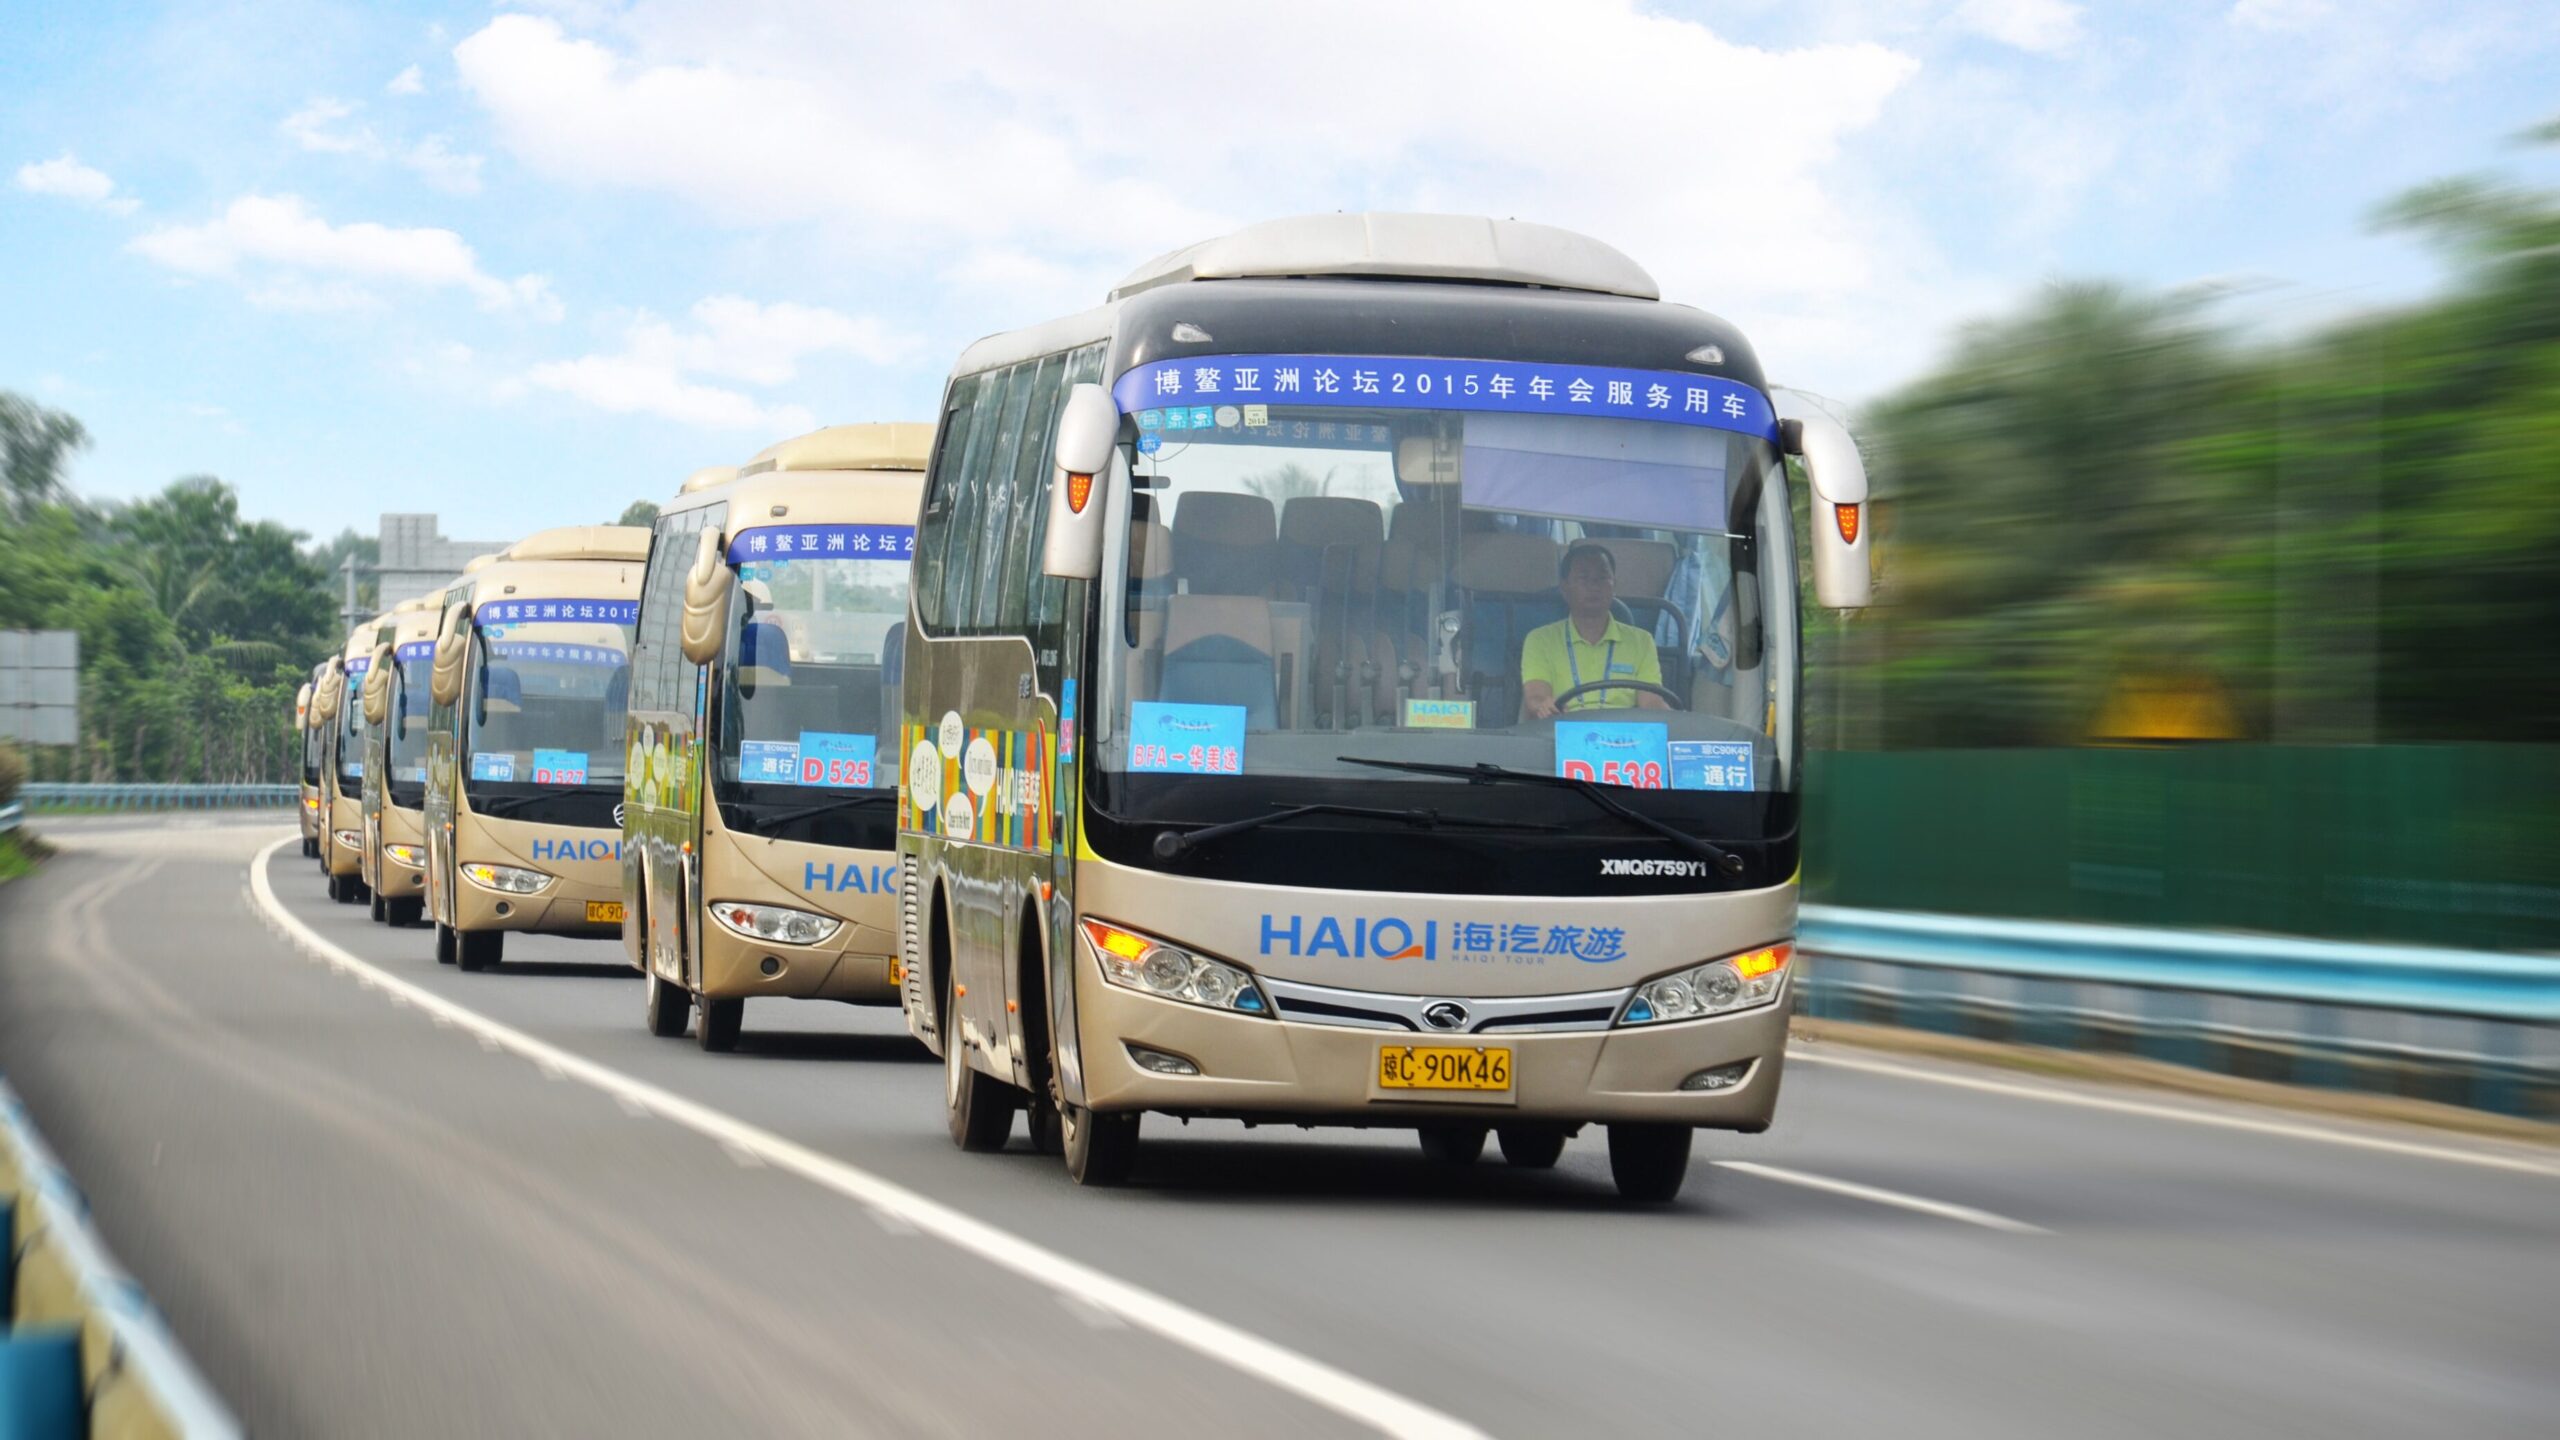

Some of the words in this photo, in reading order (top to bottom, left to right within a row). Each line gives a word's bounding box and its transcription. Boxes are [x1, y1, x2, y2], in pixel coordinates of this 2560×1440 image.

[1154, 367, 1746, 419] 博鳌亚洲论坛2015年年会服务用车
[763, 757, 794, 774] 通行
[803, 758, 824, 783] D
[829, 759, 870, 785] 525
[1603, 761, 1663, 789] 538
[1703, 764, 1747, 787] 通行
[533, 839, 622, 861] HAIQI
[1600, 859, 1707, 877] XMQ6759Y1
[1260, 914, 1437, 961] HAIQI
[1452, 922, 1627, 963] 海汽旅游
